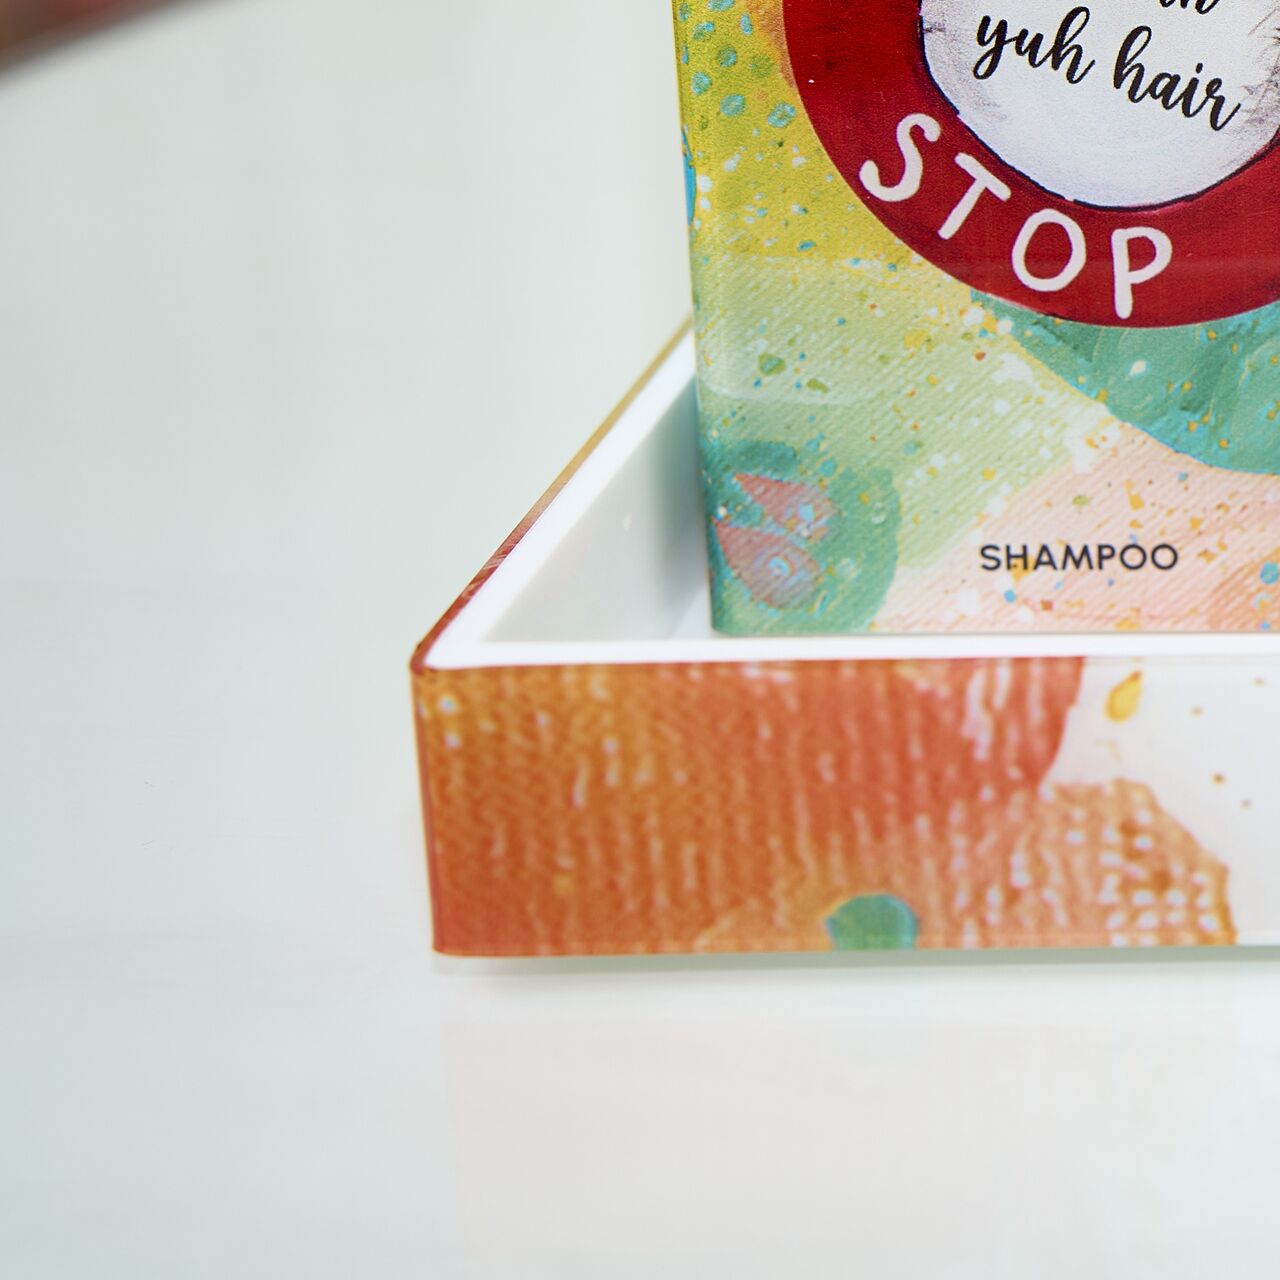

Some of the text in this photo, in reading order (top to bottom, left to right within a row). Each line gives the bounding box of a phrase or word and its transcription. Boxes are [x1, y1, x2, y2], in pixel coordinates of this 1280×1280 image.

[974, 6, 1242, 131] yuh hair
[858, 112, 1173, 320] STOP
[980, 544, 1179, 571] SHAMPOO
